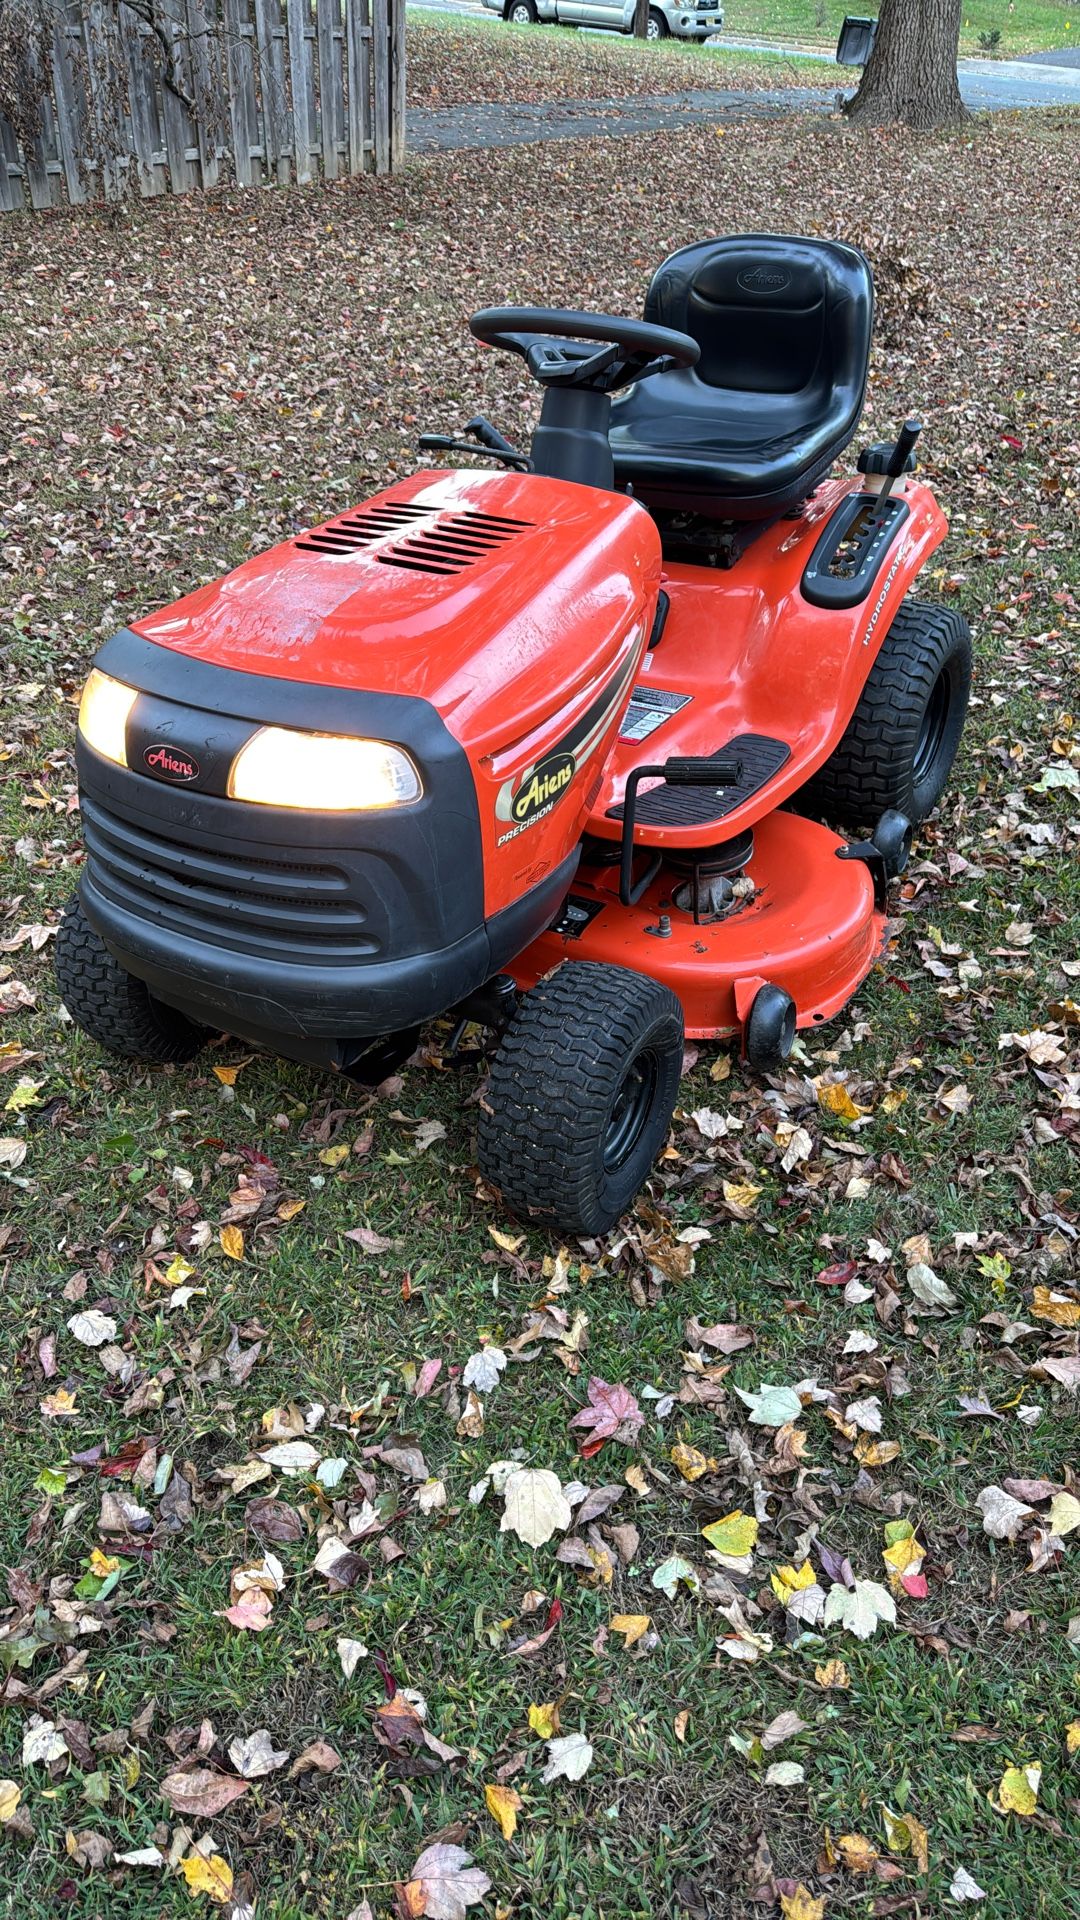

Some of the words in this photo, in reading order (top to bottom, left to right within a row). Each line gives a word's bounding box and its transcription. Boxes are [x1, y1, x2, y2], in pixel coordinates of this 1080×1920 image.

[862, 543, 906, 646] HYDROSTATIC
[148, 749, 193, 776] Ariens
[515, 763, 572, 817] Ariens
[497, 801, 554, 847] PRECISION
